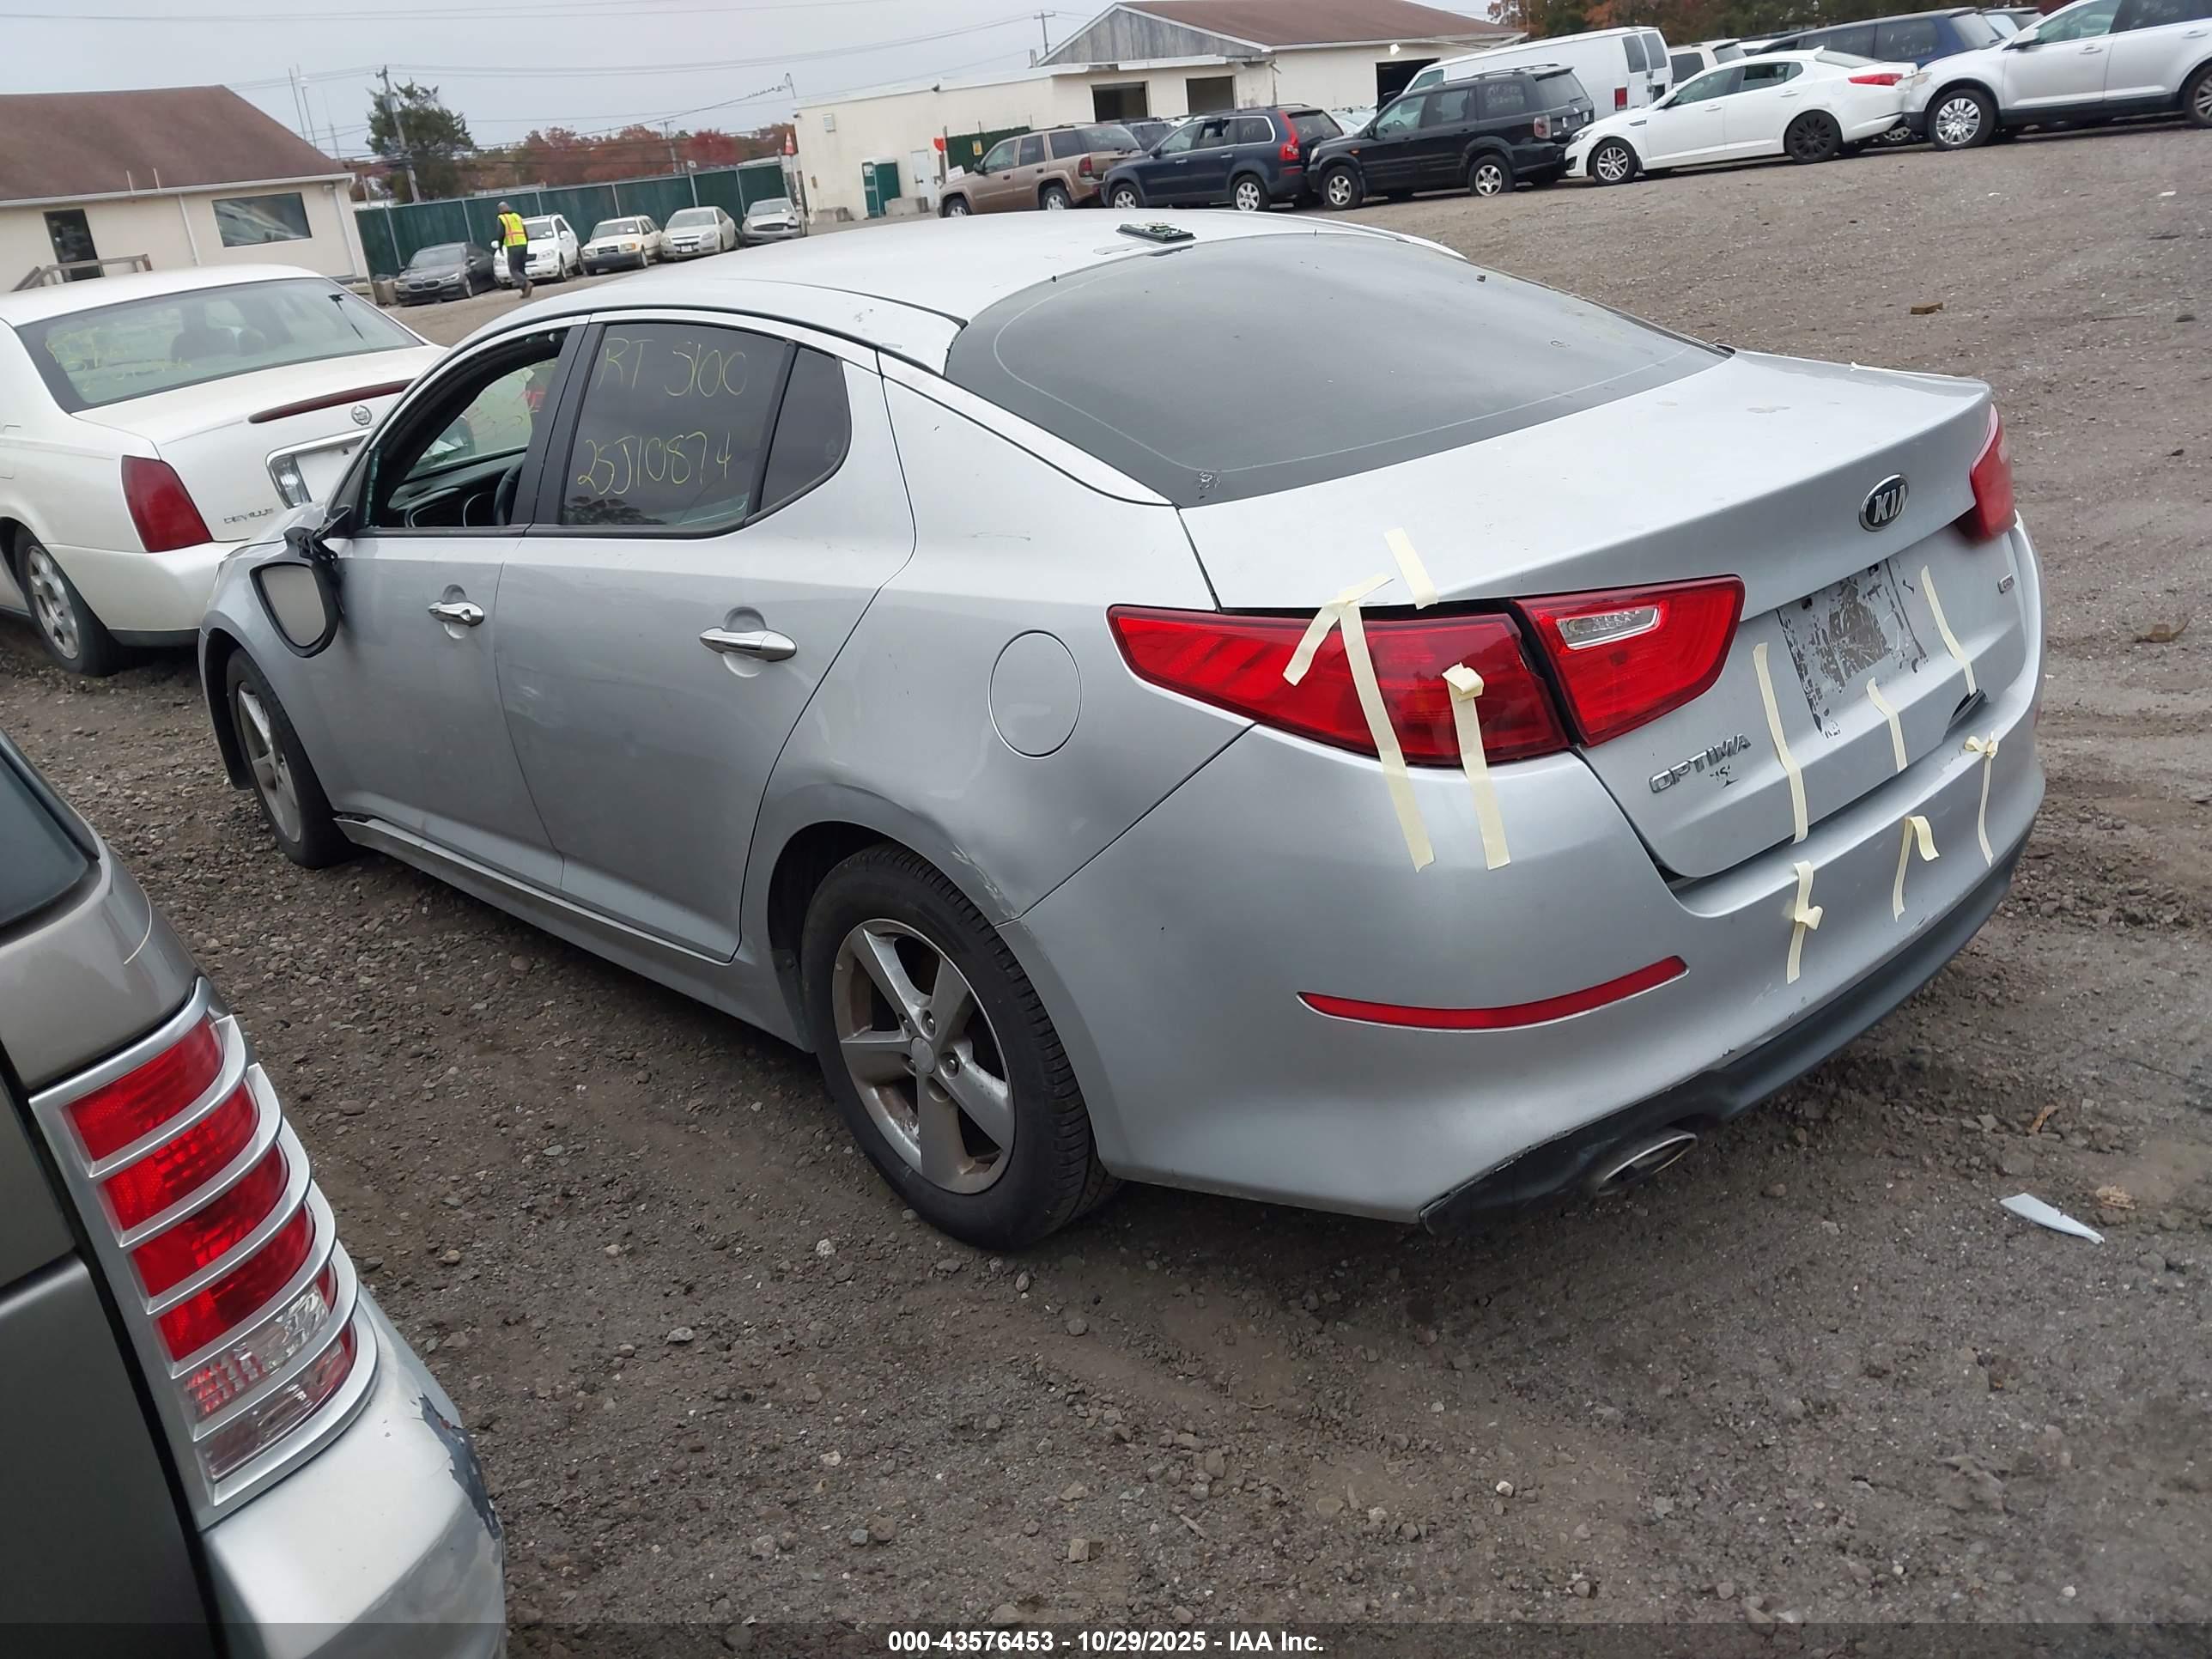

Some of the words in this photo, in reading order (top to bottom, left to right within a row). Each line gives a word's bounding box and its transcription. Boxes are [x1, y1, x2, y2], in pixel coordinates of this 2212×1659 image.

[596, 337, 653, 391] RT
[1871, 483, 1907, 525] KIA
[1649, 733, 1753, 793] OPTIMA
